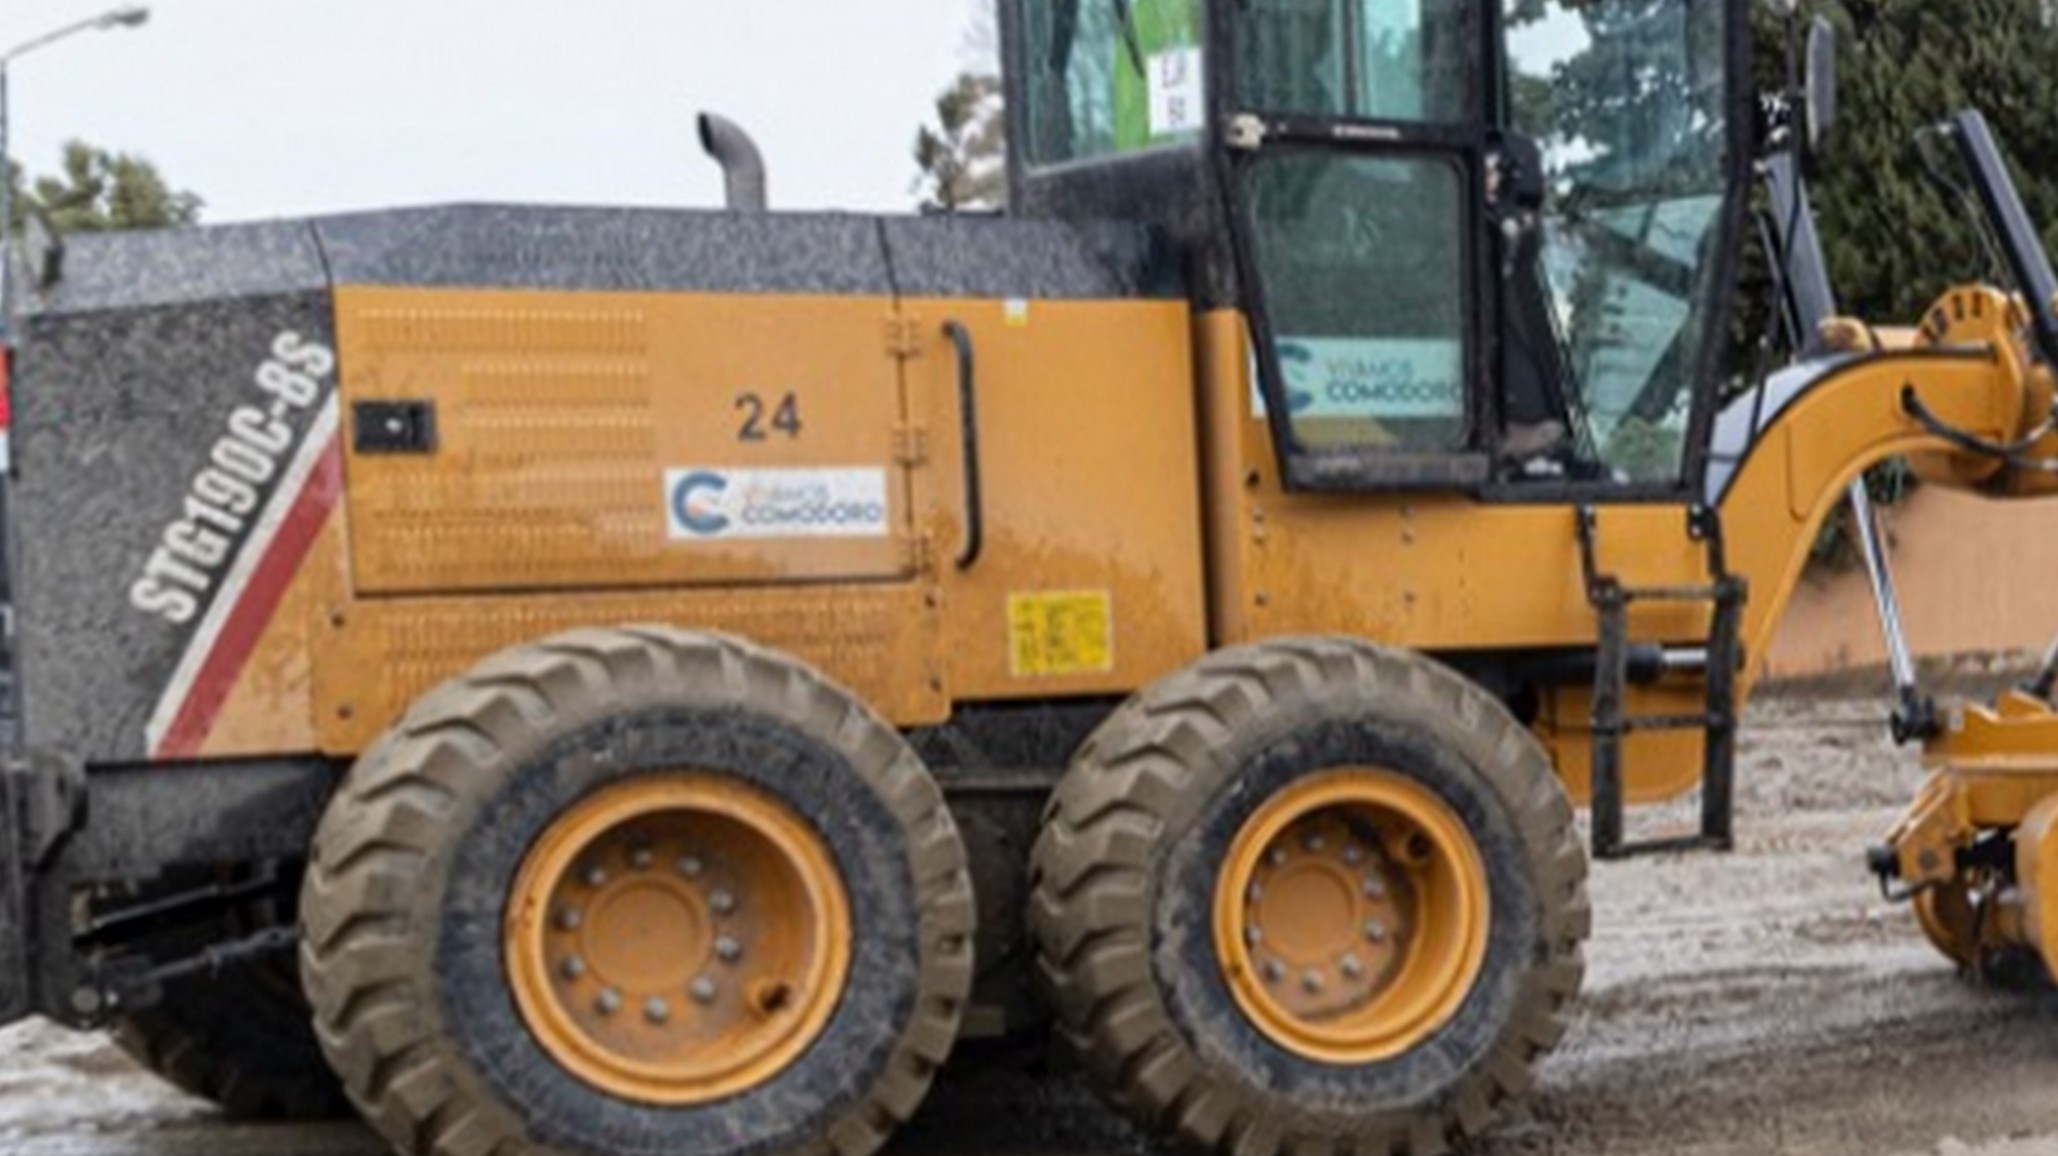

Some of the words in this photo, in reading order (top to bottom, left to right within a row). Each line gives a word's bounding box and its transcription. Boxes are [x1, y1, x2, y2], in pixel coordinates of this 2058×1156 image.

[735, 391, 802, 441] 24
[130, 330, 334, 623] STG190C-8S
[741, 502, 884, 525] COMODORO
